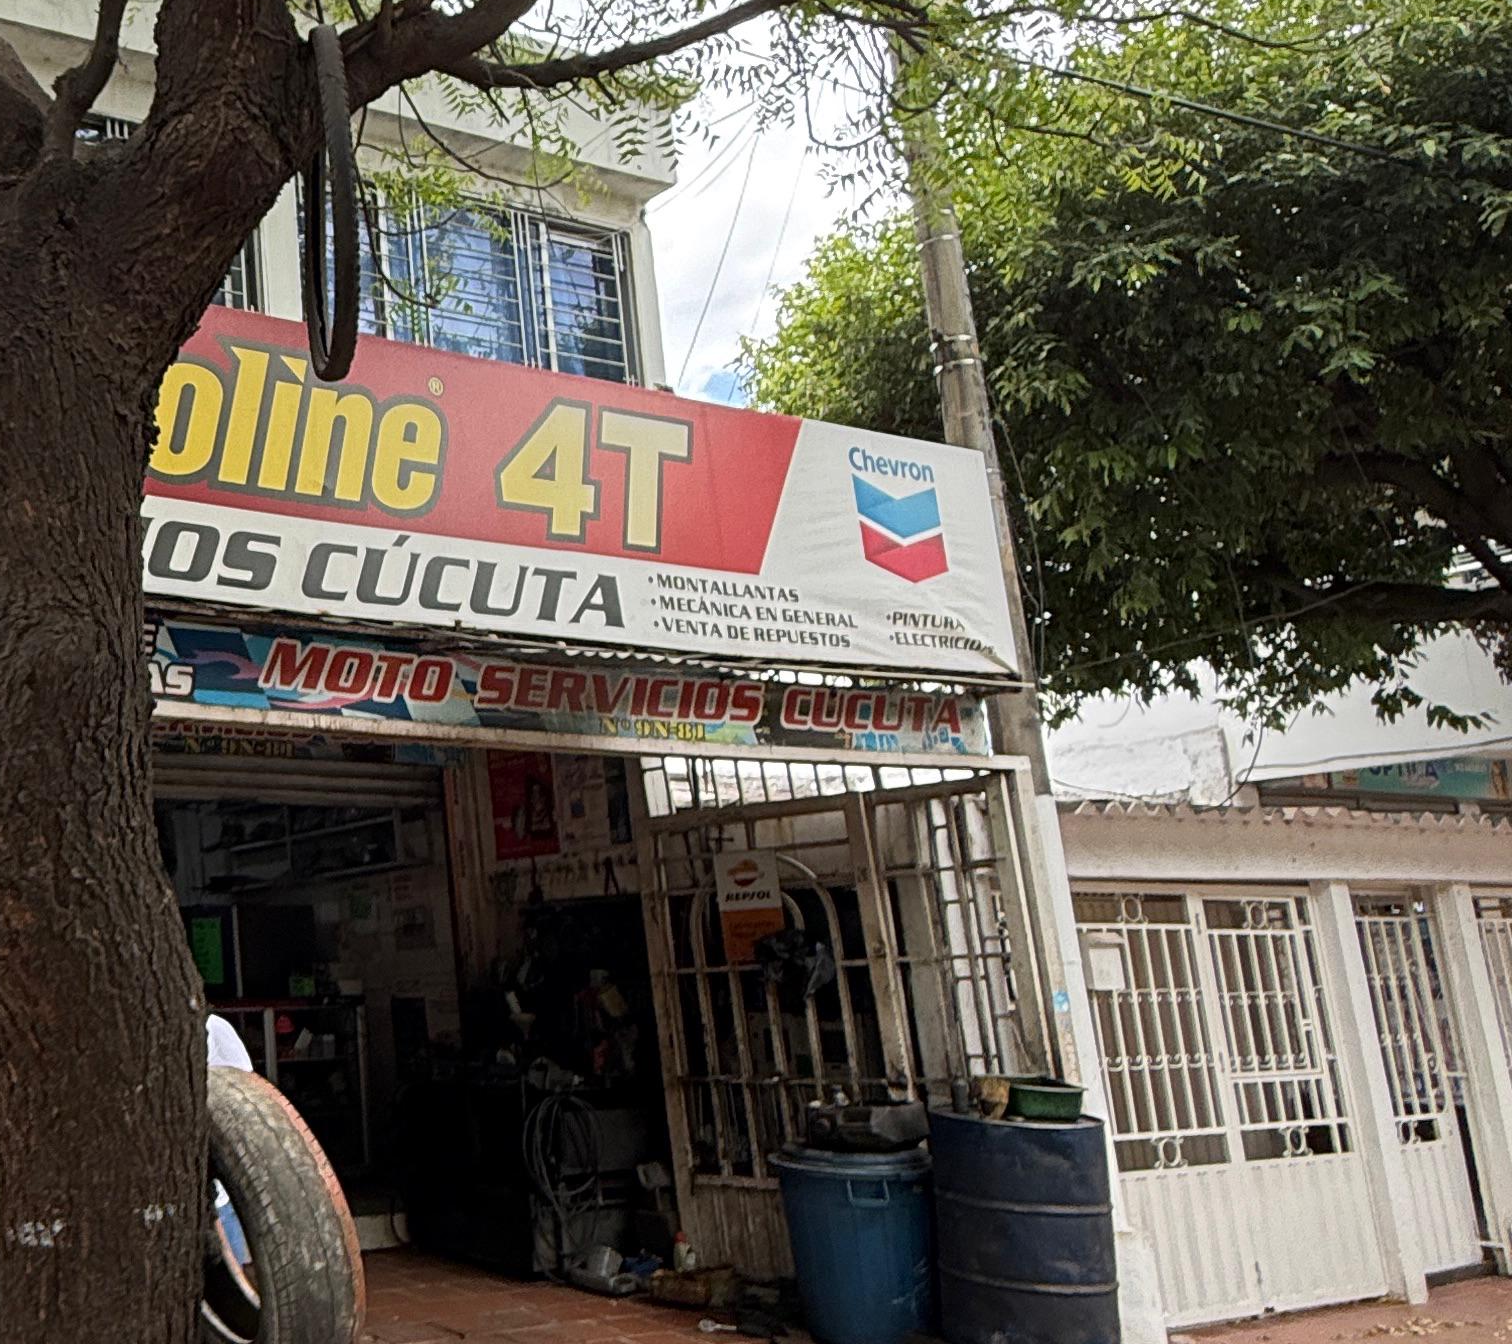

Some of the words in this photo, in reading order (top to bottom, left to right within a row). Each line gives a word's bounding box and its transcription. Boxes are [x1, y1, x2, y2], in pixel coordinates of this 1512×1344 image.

[501, 404, 688, 548] 4T
[848, 446, 934, 484] Chevron
[302, 534, 625, 628] CÚCUTA
[656, 573, 799, 603] MONTALLANTAS
[659, 594, 752, 620] MECÁNICA
[756, 605, 778, 622] EN
[782, 609, 859, 629] GENERAL
[892, 611, 965, 632] PINTURA
[661, 616, 723, 639] VENTA
[727, 625, 750, 641] DE
[754, 627, 851, 648] REPUESTOS
[259, 637, 457, 704] MOTO
[475, 659, 765, 723] SERVICIOS
[780, 686, 962, 735] CUCUTA
